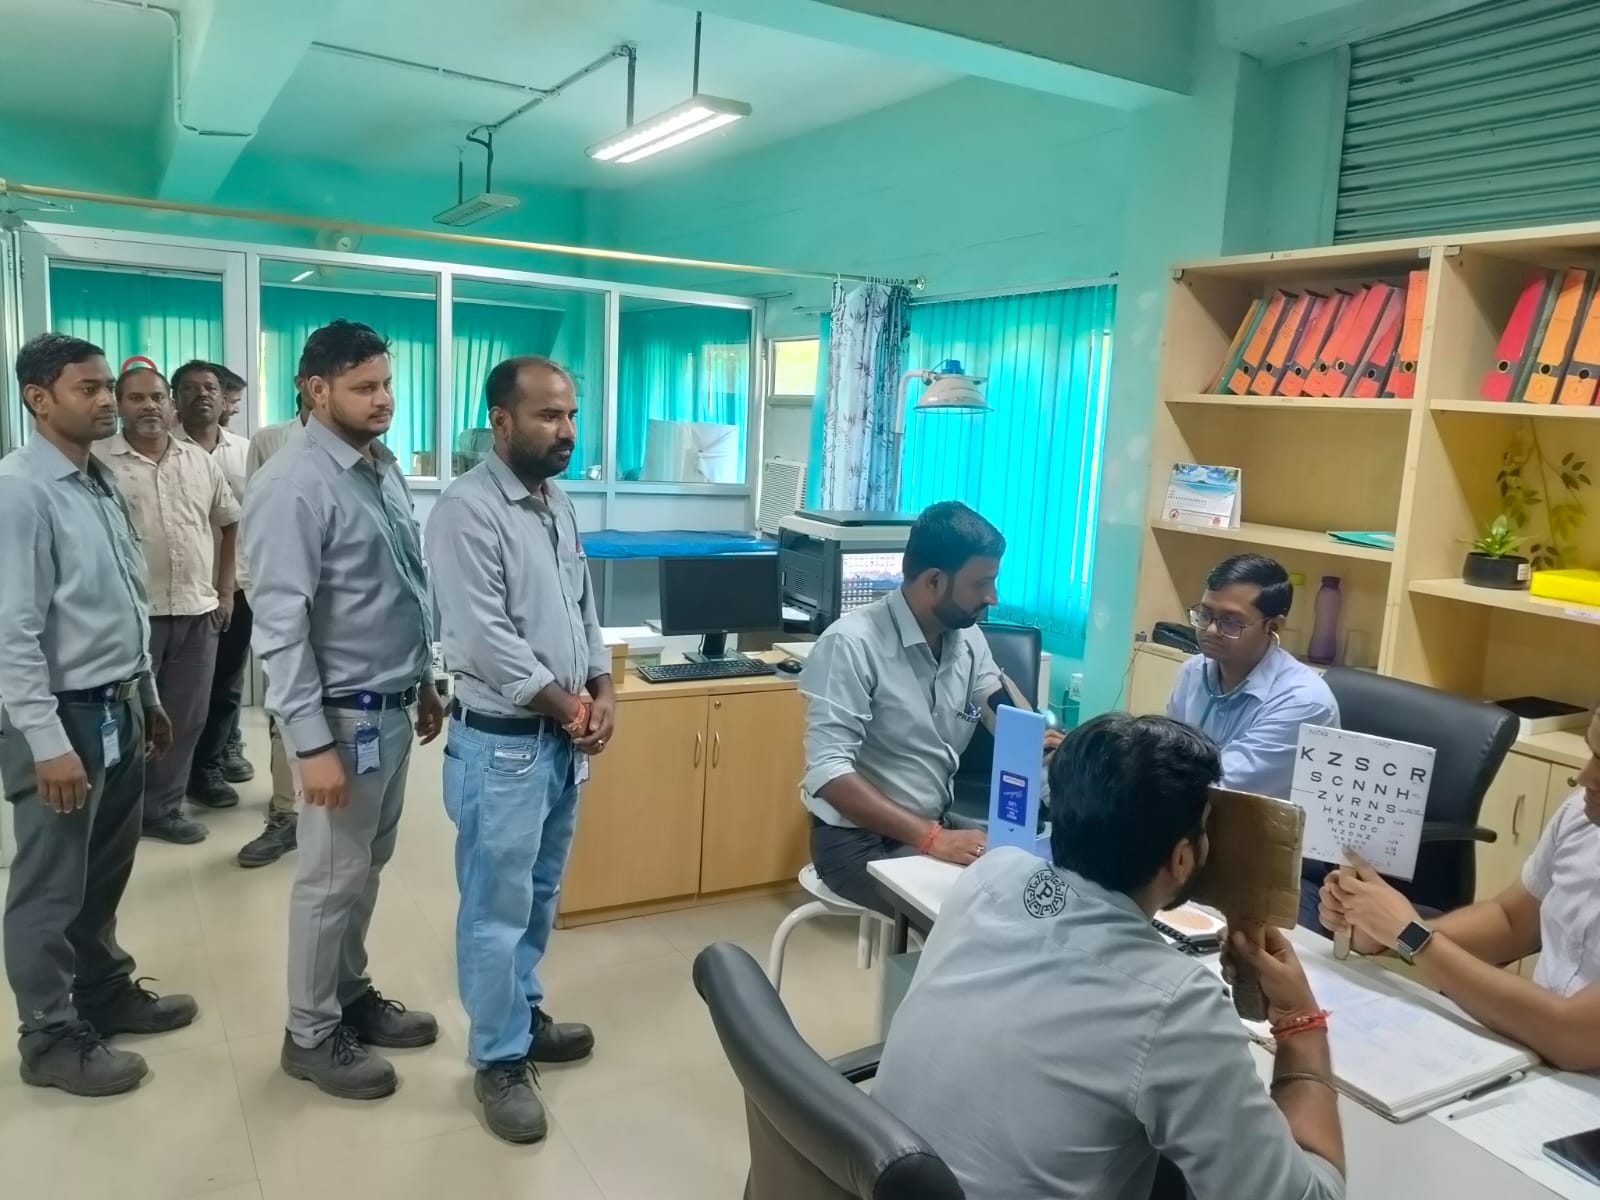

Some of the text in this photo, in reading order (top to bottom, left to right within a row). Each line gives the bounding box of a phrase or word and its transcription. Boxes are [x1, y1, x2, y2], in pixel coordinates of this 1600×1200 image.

[1301, 746, 1426, 783] K Z S C R
[1310, 771, 1322, 782] S
[1332, 776, 1343, 786] C
[1353, 779, 1365, 791] N
[1374, 784, 1387, 795] N
[1396, 788, 1409, 800] H
[1318, 790, 1327, 800] Z
[1336, 794, 1344, 802] V
[1351, 797, 1361, 806] R
[1368, 800, 1378, 810] N
[1386, 804, 1396, 814] S
